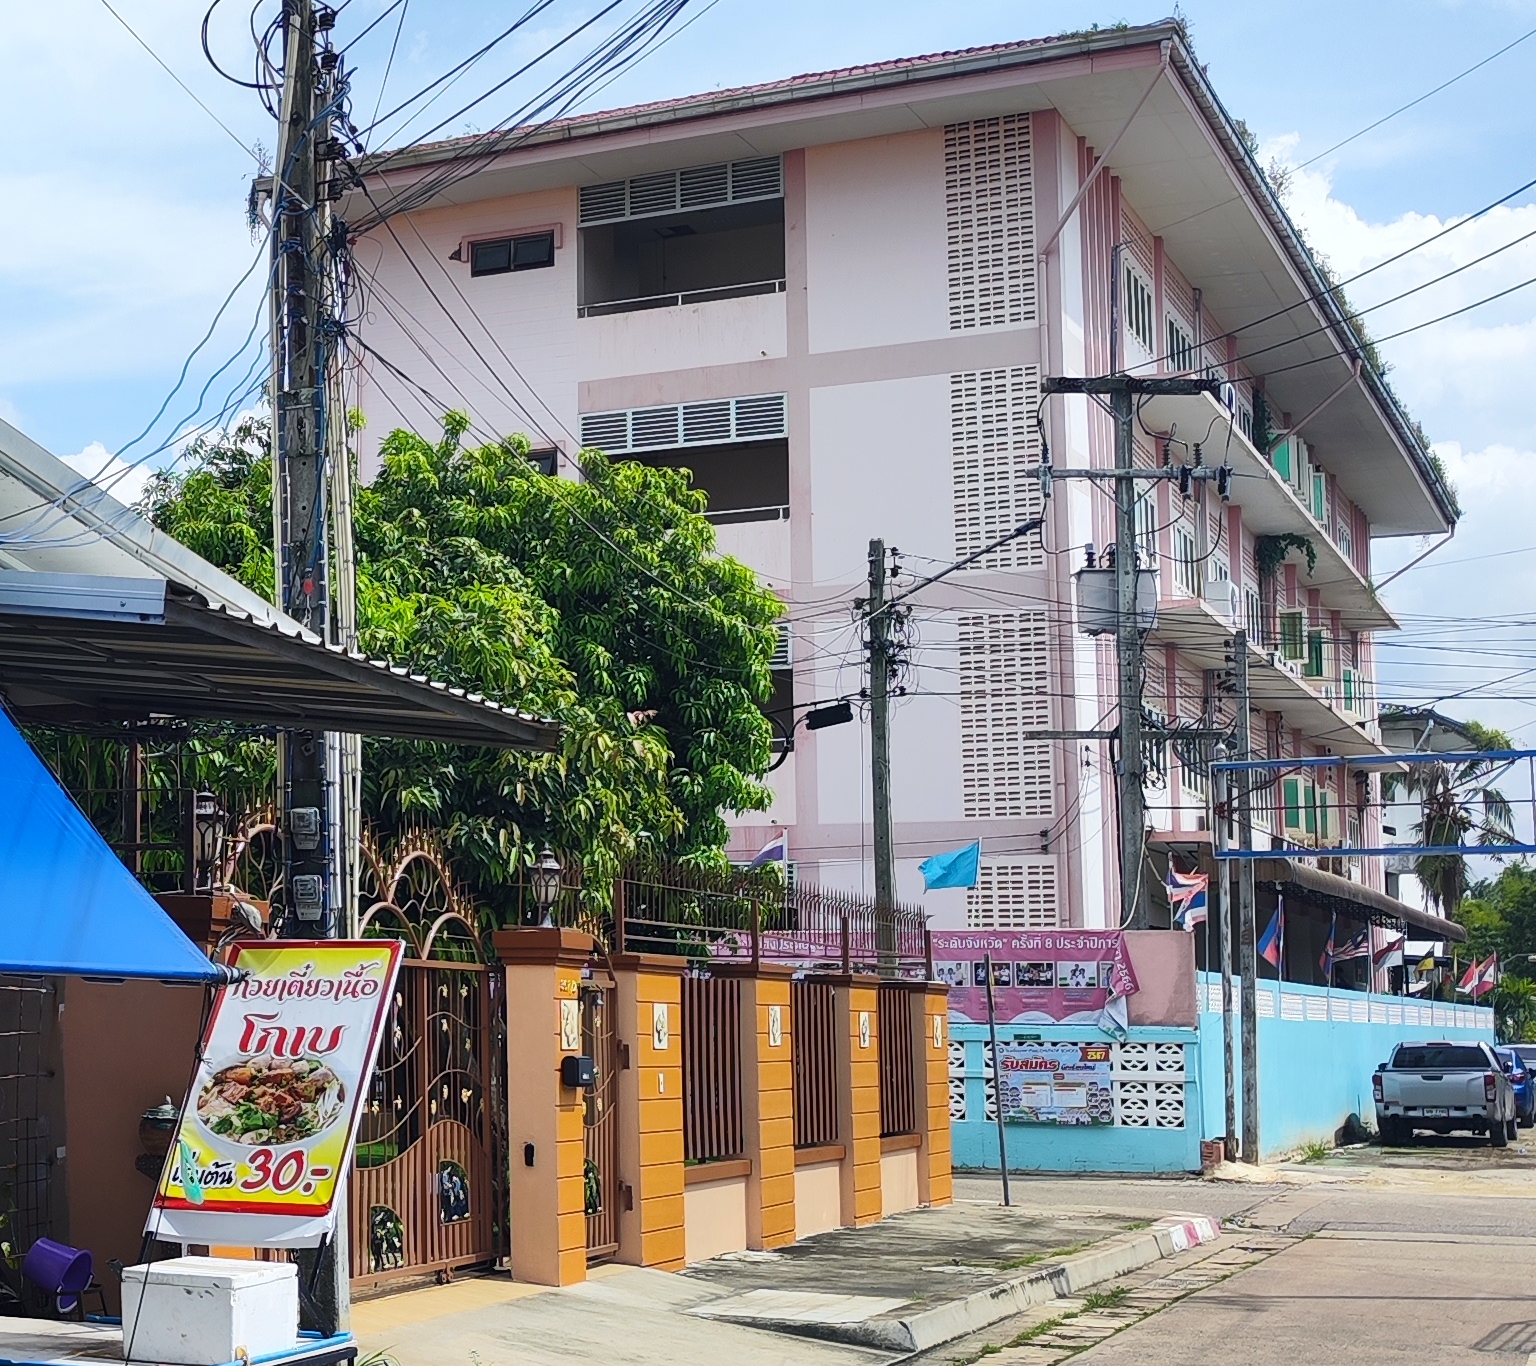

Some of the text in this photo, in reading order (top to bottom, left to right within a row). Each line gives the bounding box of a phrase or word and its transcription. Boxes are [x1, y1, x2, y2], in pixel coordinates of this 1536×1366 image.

[1045, 938, 1053, 949] 8
[232, 962, 379, 1002] กวยเตี๋ยวเนื้อ
[239, 1013, 346, 1058] โกเบ
[241, 1148, 330, 1193] 30.-
